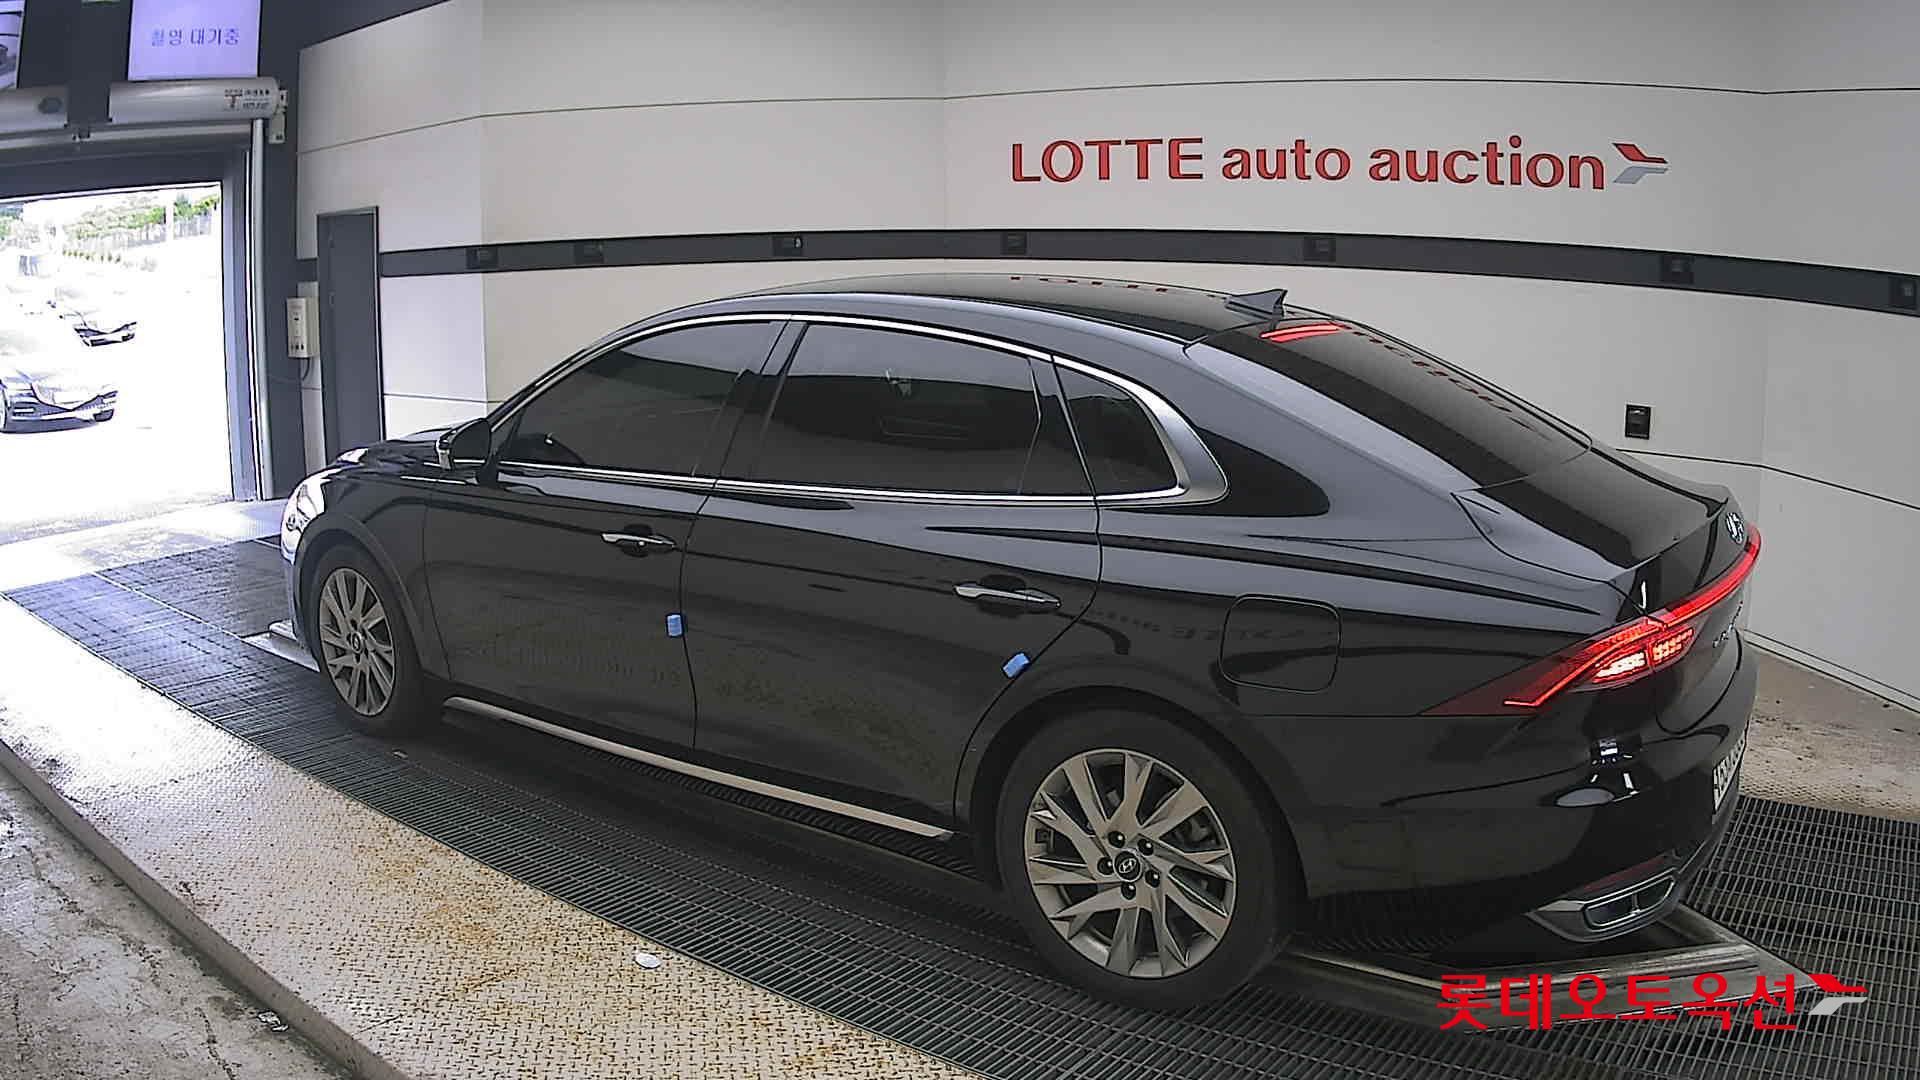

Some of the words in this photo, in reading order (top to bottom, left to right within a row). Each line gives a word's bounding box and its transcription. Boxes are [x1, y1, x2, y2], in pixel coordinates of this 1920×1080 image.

[1012, 138, 1203, 182] LOTTE
[1223, 139, 1351, 181] auto
[1368, 135, 1605, 190] auction
